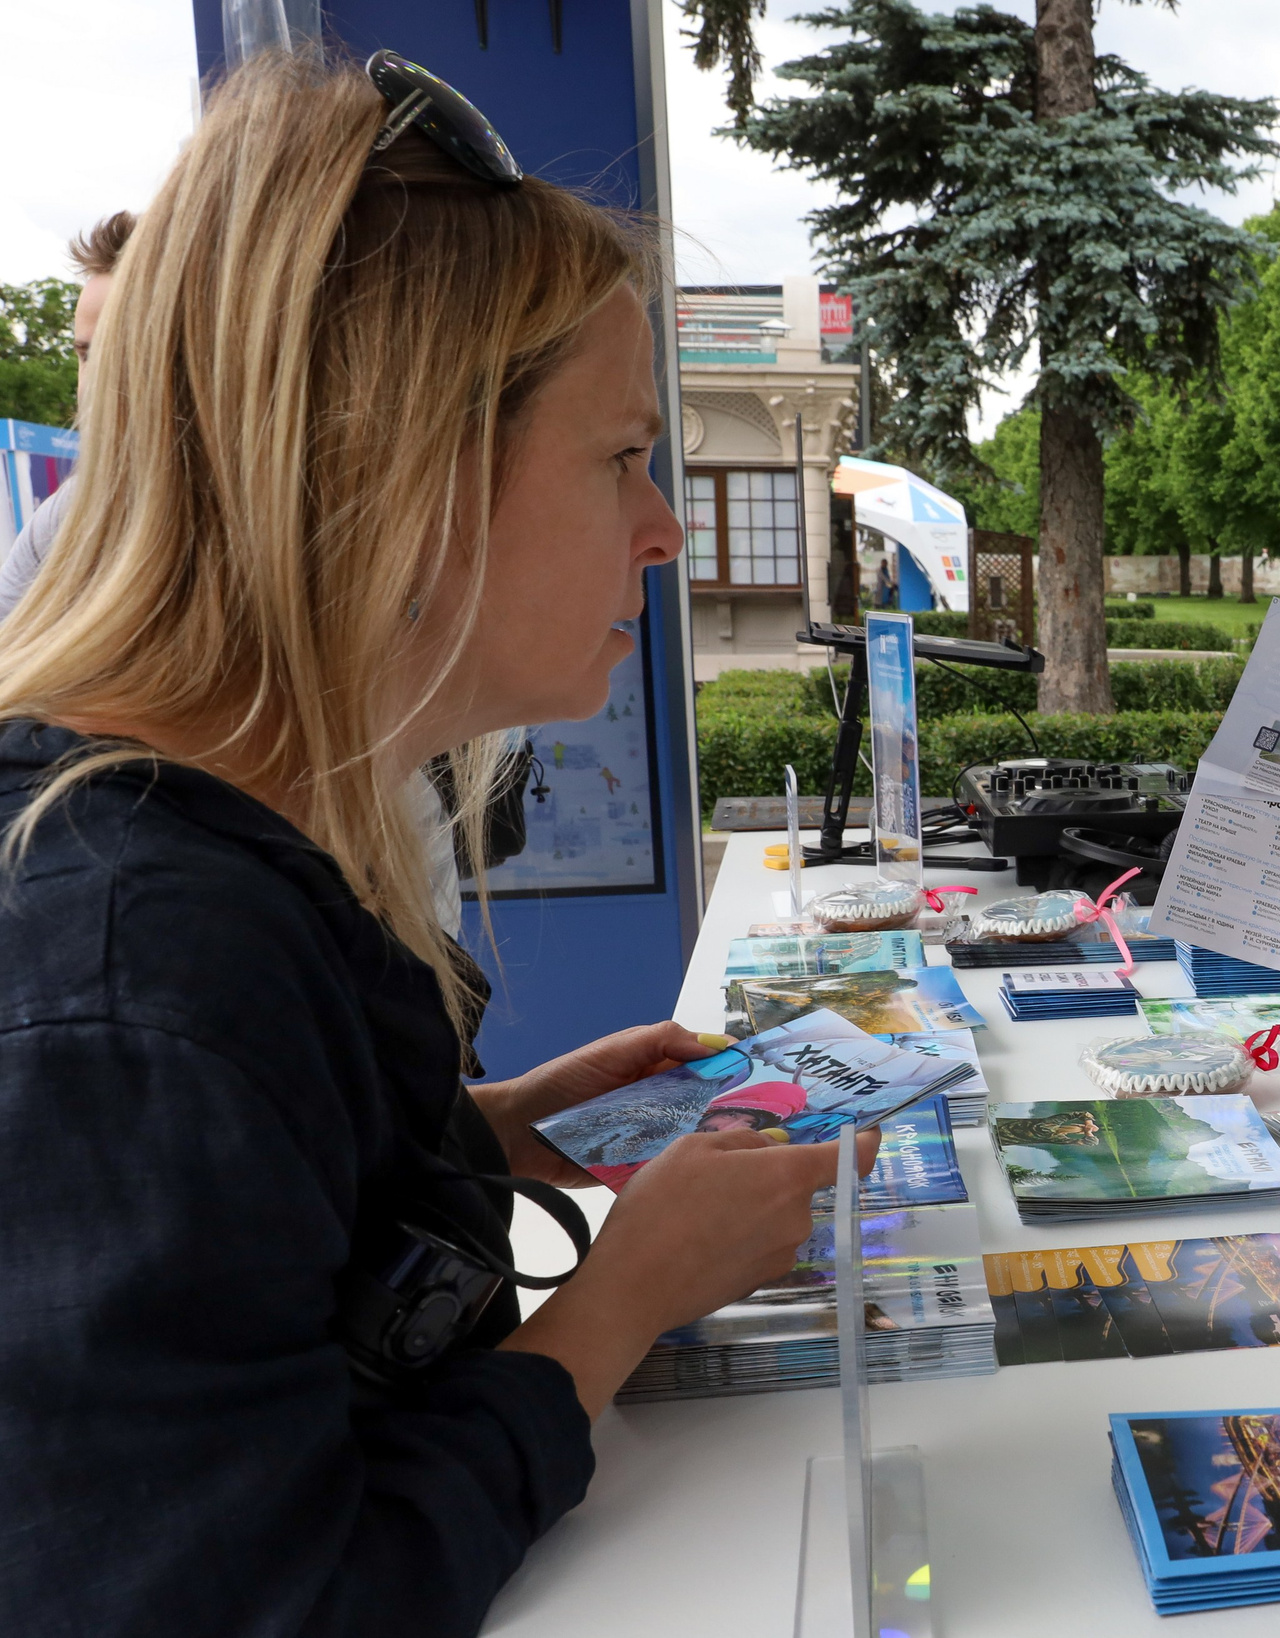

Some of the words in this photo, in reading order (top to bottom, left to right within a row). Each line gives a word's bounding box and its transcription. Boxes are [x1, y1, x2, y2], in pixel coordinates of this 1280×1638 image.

[1202, 804, 1218, 813] КУКОЛ
[1204, 799, 1242, 816] КРАСНОЯРСКИЙ
[1242, 811, 1256, 820] ТЕАТР
[1198, 818, 1212, 828] ТЕАТР
[1219, 825, 1237, 836] КРЫШЕ
[1188, 833, 1218, 848] Послушать
[1188, 850, 1222, 865] ФИЛАРМОНИЯ
[1189, 843, 1226, 862] КРАСНОЯРСКАЯ
[1226, 855, 1246, 867] КРАЕВАЯ
[1178, 864, 1212, 882] Посмотреть
[1178, 880, 1206, 894] «ПЛОЩАДЬ
[1206, 889, 1222, 898] МИРА»
[1179, 874, 1205, 888] МУЗЕЙНЫЙ
[1205, 882, 1222, 892] ЦЕНТР
[1170, 904, 1207, 921] МУЗЕЙ-УСАДЬБА
[1216, 920, 1235, 930] ЮДИНА
[783, 1044, 890, 1096] ХАТАНГЕ
[895, 1123, 930, 1189] КРАСНОЯРСК
[1237, 1142, 1275, 1173] ЕРГАКИ
[932, 1264, 967, 1319] ЕНИСЕЙСК
